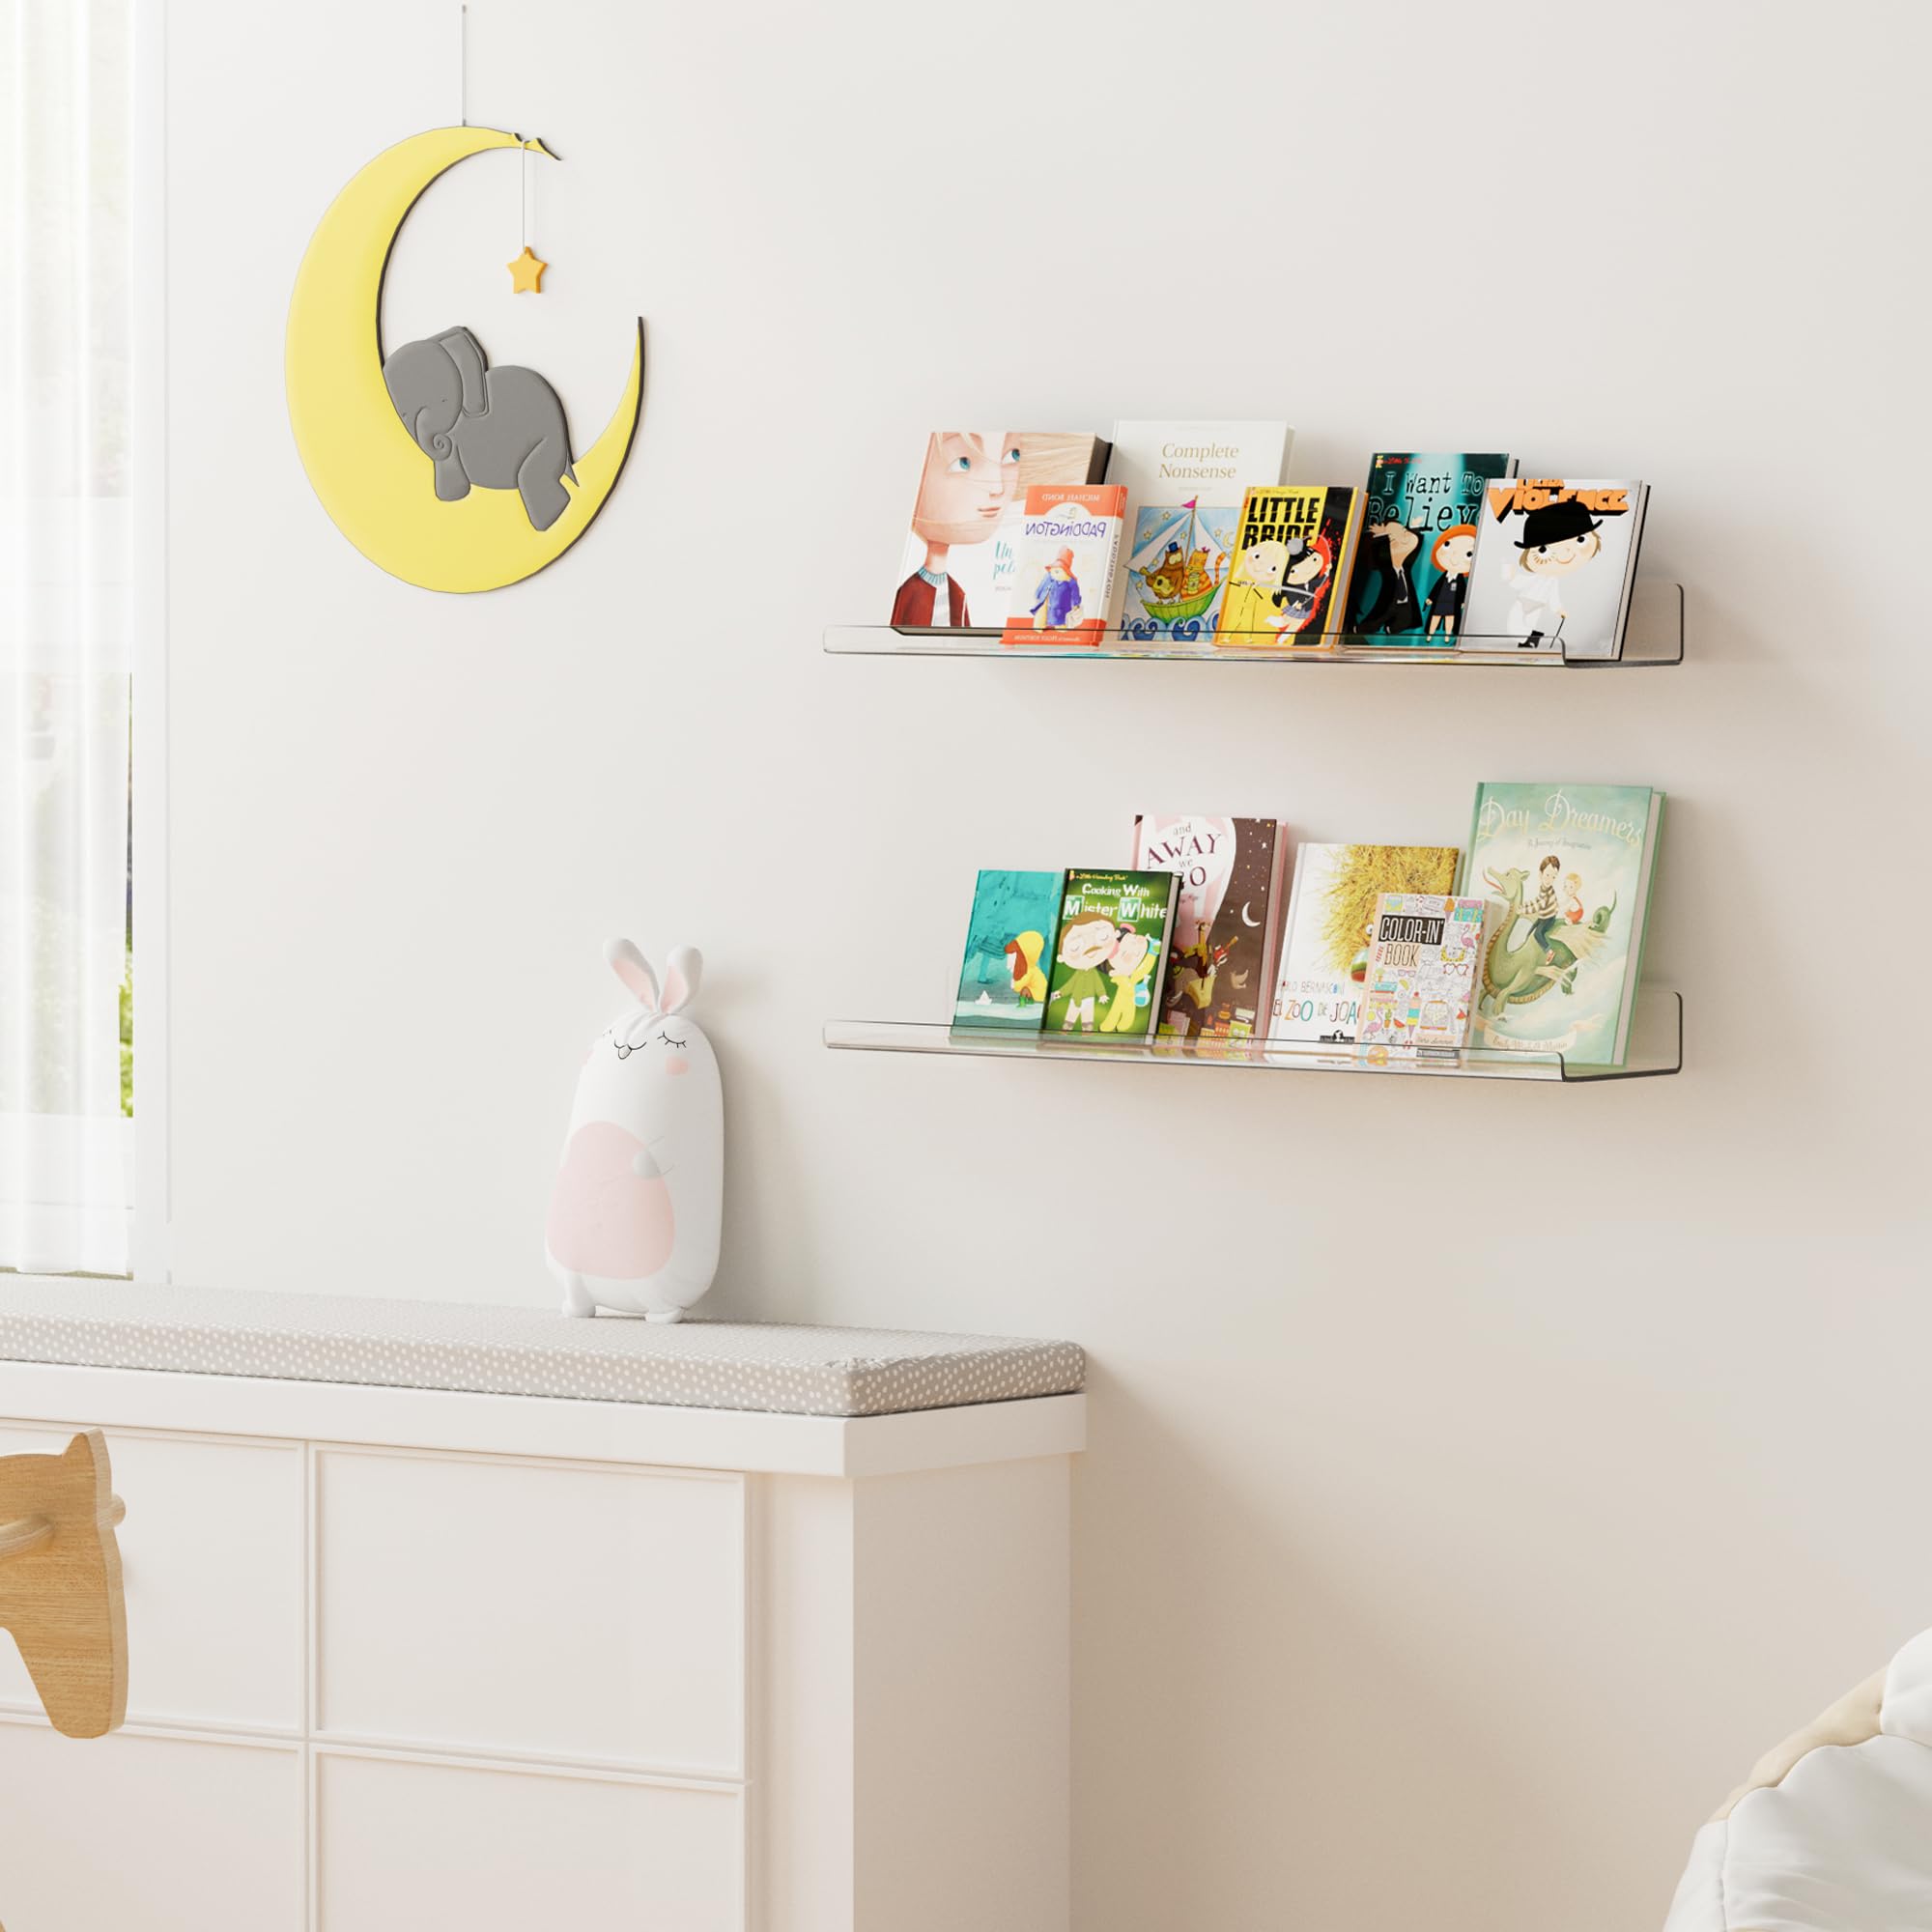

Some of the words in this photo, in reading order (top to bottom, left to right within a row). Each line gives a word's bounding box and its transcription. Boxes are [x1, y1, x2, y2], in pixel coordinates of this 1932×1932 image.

[1161, 442, 1239, 463] Complete
[1158, 463, 1236, 479] Nonsense
[1381, 470, 1397, 496] I
[1405, 470, 1453, 495] Want
[1461, 470, 1485, 496] To
[1247, 497, 1321, 524] LITTLE
[1367, 496, 1482, 533] Believ
[1241, 525, 1315, 551] BRIDE
[1173, 821, 1191, 836] and
[1476, 796, 1530, 841] Day
[1538, 788, 1642, 847] Dreamers
[1147, 833, 1222, 869] AWAY
[1178, 859, 1194, 868] we
[1081, 883, 1122, 898] Cooking
[1122, 884, 1151, 897] With
[1065, 898, 1119, 917] Mister
[1121, 901, 1168, 920] White
[1383, 943, 1420, 967] BOOK
[1284, 999, 1314, 1022] ZOO
